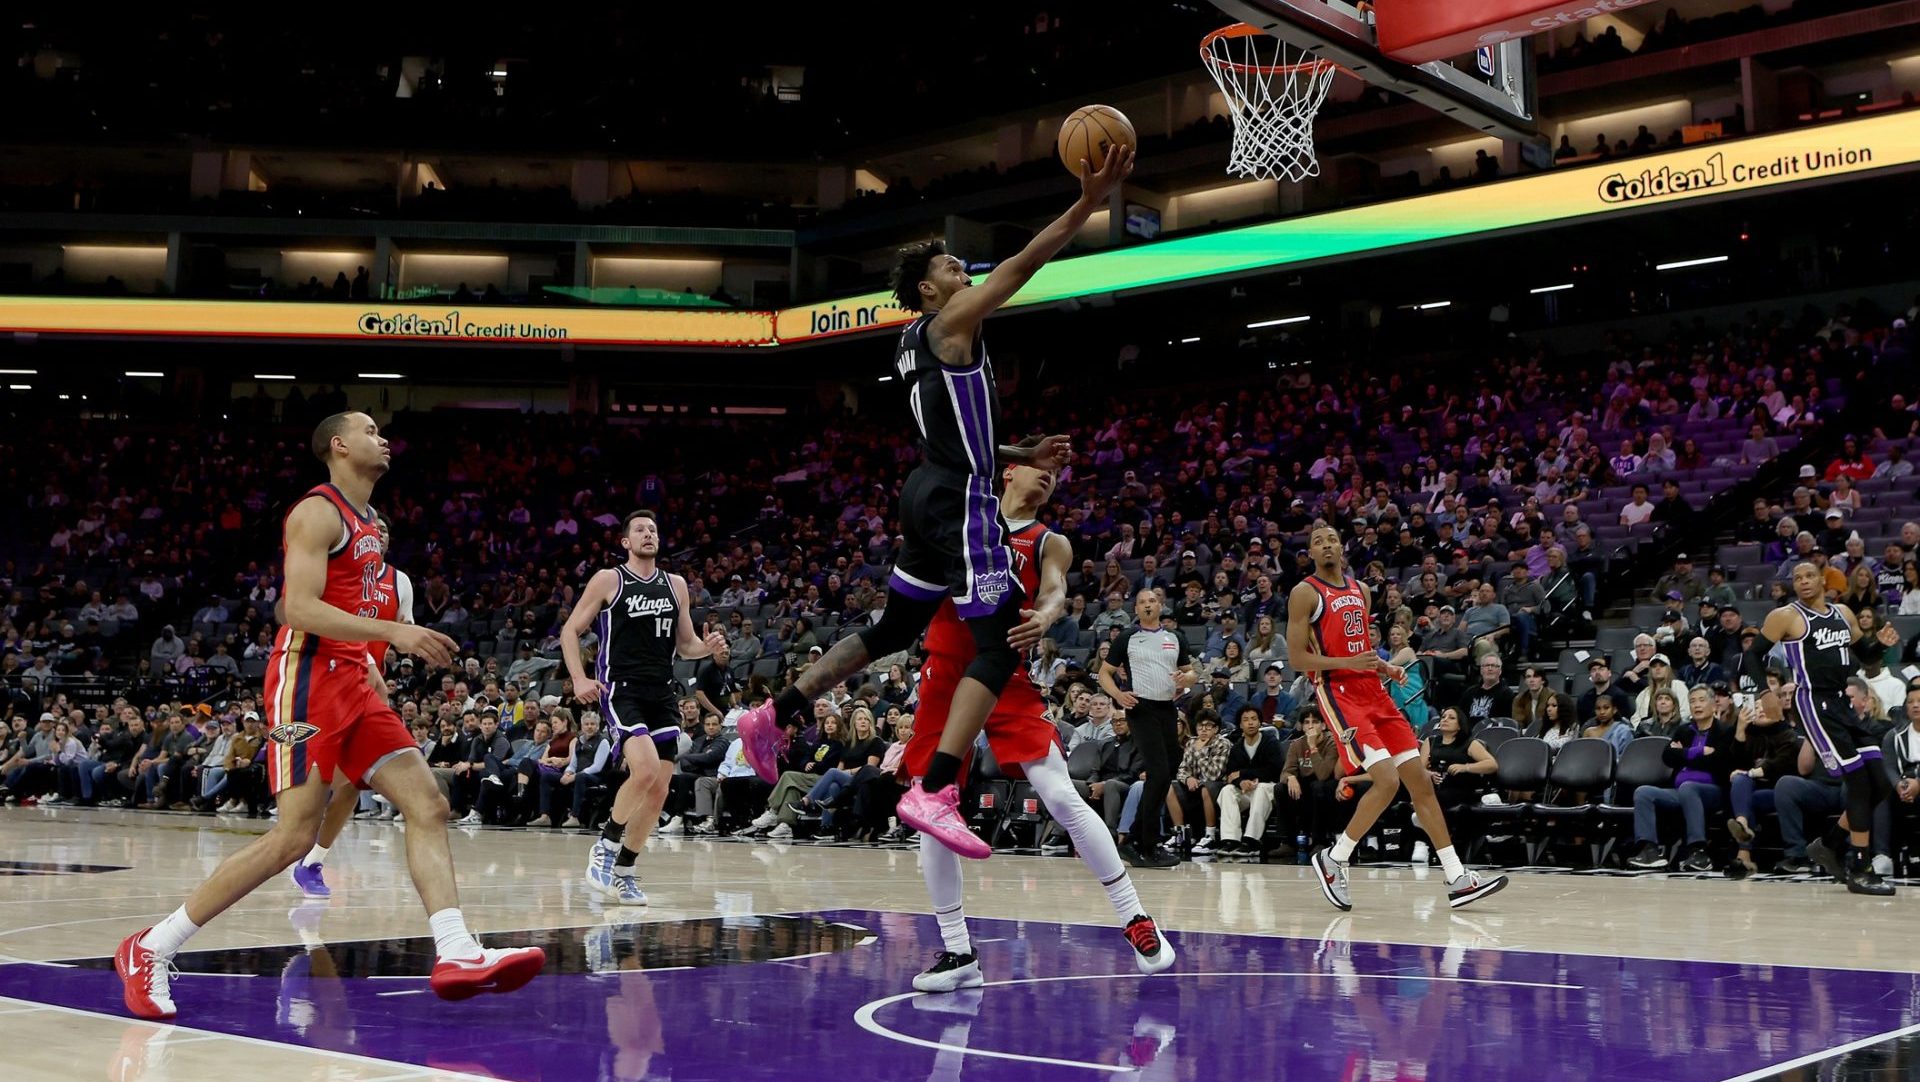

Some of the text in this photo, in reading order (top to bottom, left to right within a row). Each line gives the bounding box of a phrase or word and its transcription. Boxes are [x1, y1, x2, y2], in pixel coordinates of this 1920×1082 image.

[1732, 156, 1799, 183] Credit
[1805, 147, 1872, 171] Union
[811, 305, 850, 334] Join
[464, 323, 515, 338] Credit
[520, 324, 567, 339] Union
[979, 584, 1007, 593] KINGS
[625, 595, 673, 618] Kings
[1343, 610, 1364, 637] 25
[1348, 640, 1364, 652] CITY
[1813, 628, 1851, 650] Kings
